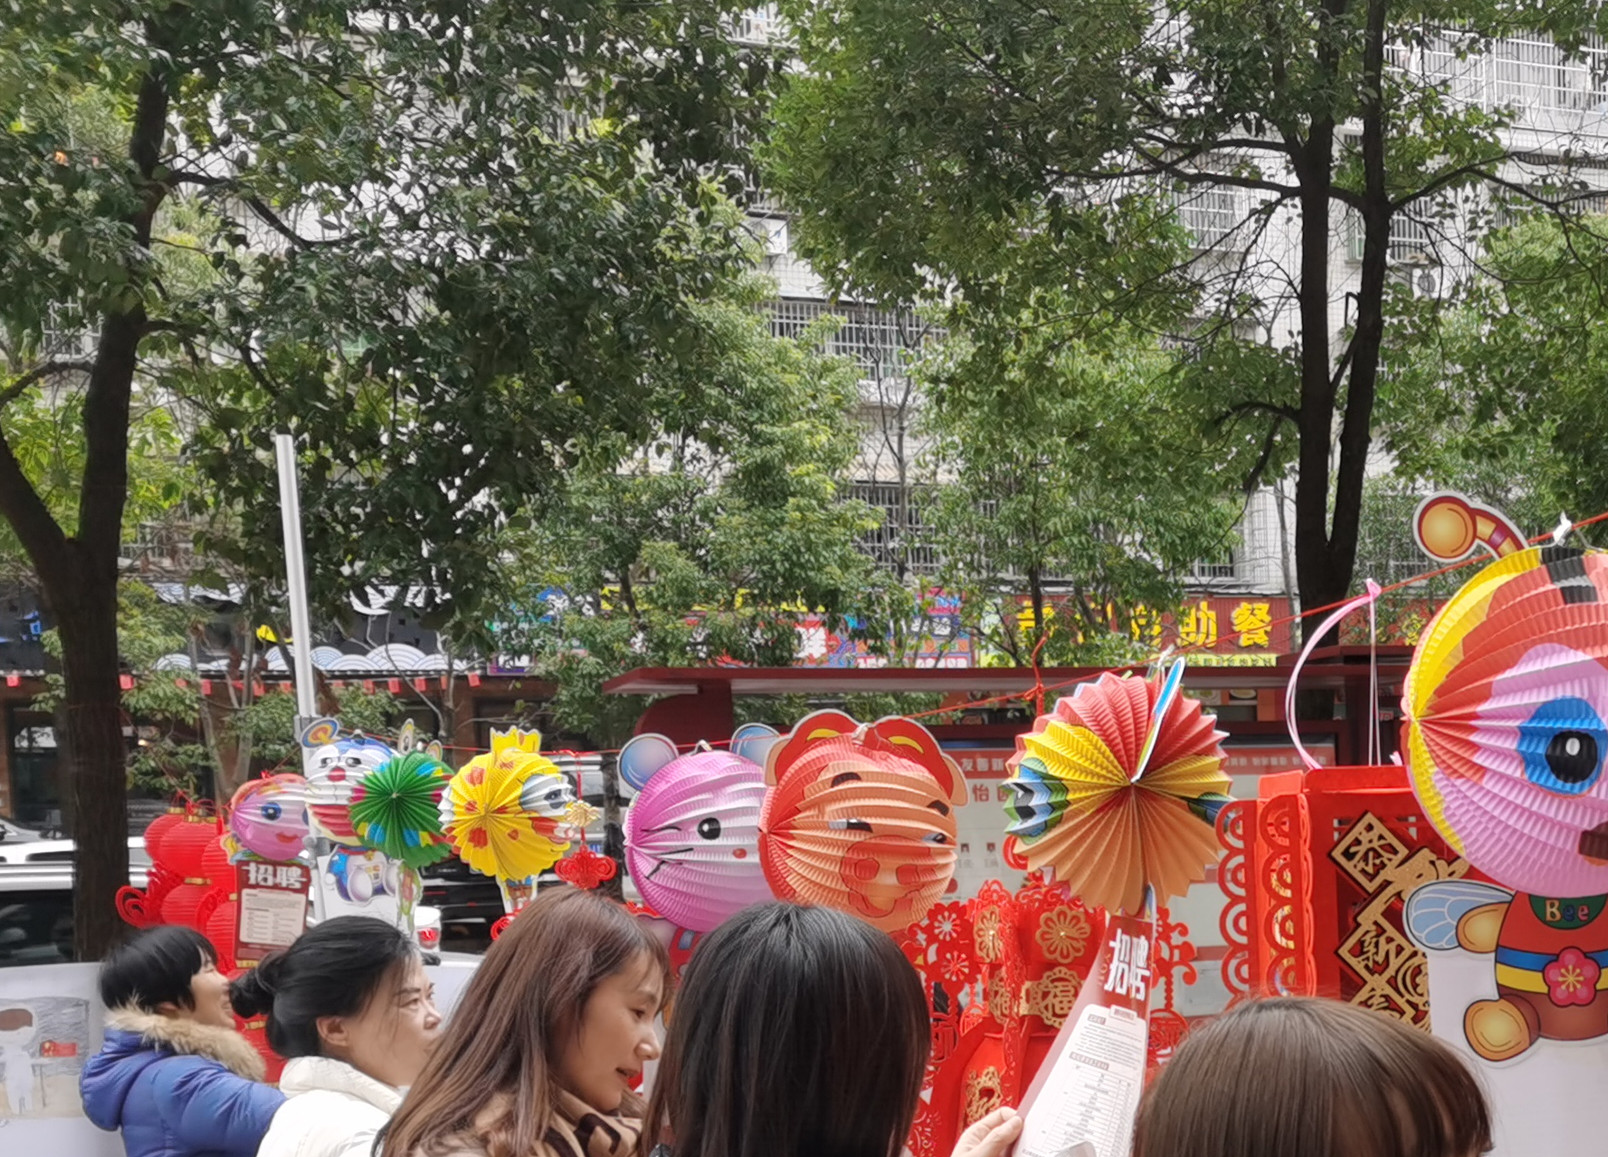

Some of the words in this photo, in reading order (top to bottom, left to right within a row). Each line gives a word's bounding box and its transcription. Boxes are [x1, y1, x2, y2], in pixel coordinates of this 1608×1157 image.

[241, 862, 308, 889] 招聘
[1545, 899, 1590, 921] Bee
[1103, 927, 1152, 1002] 招聘
